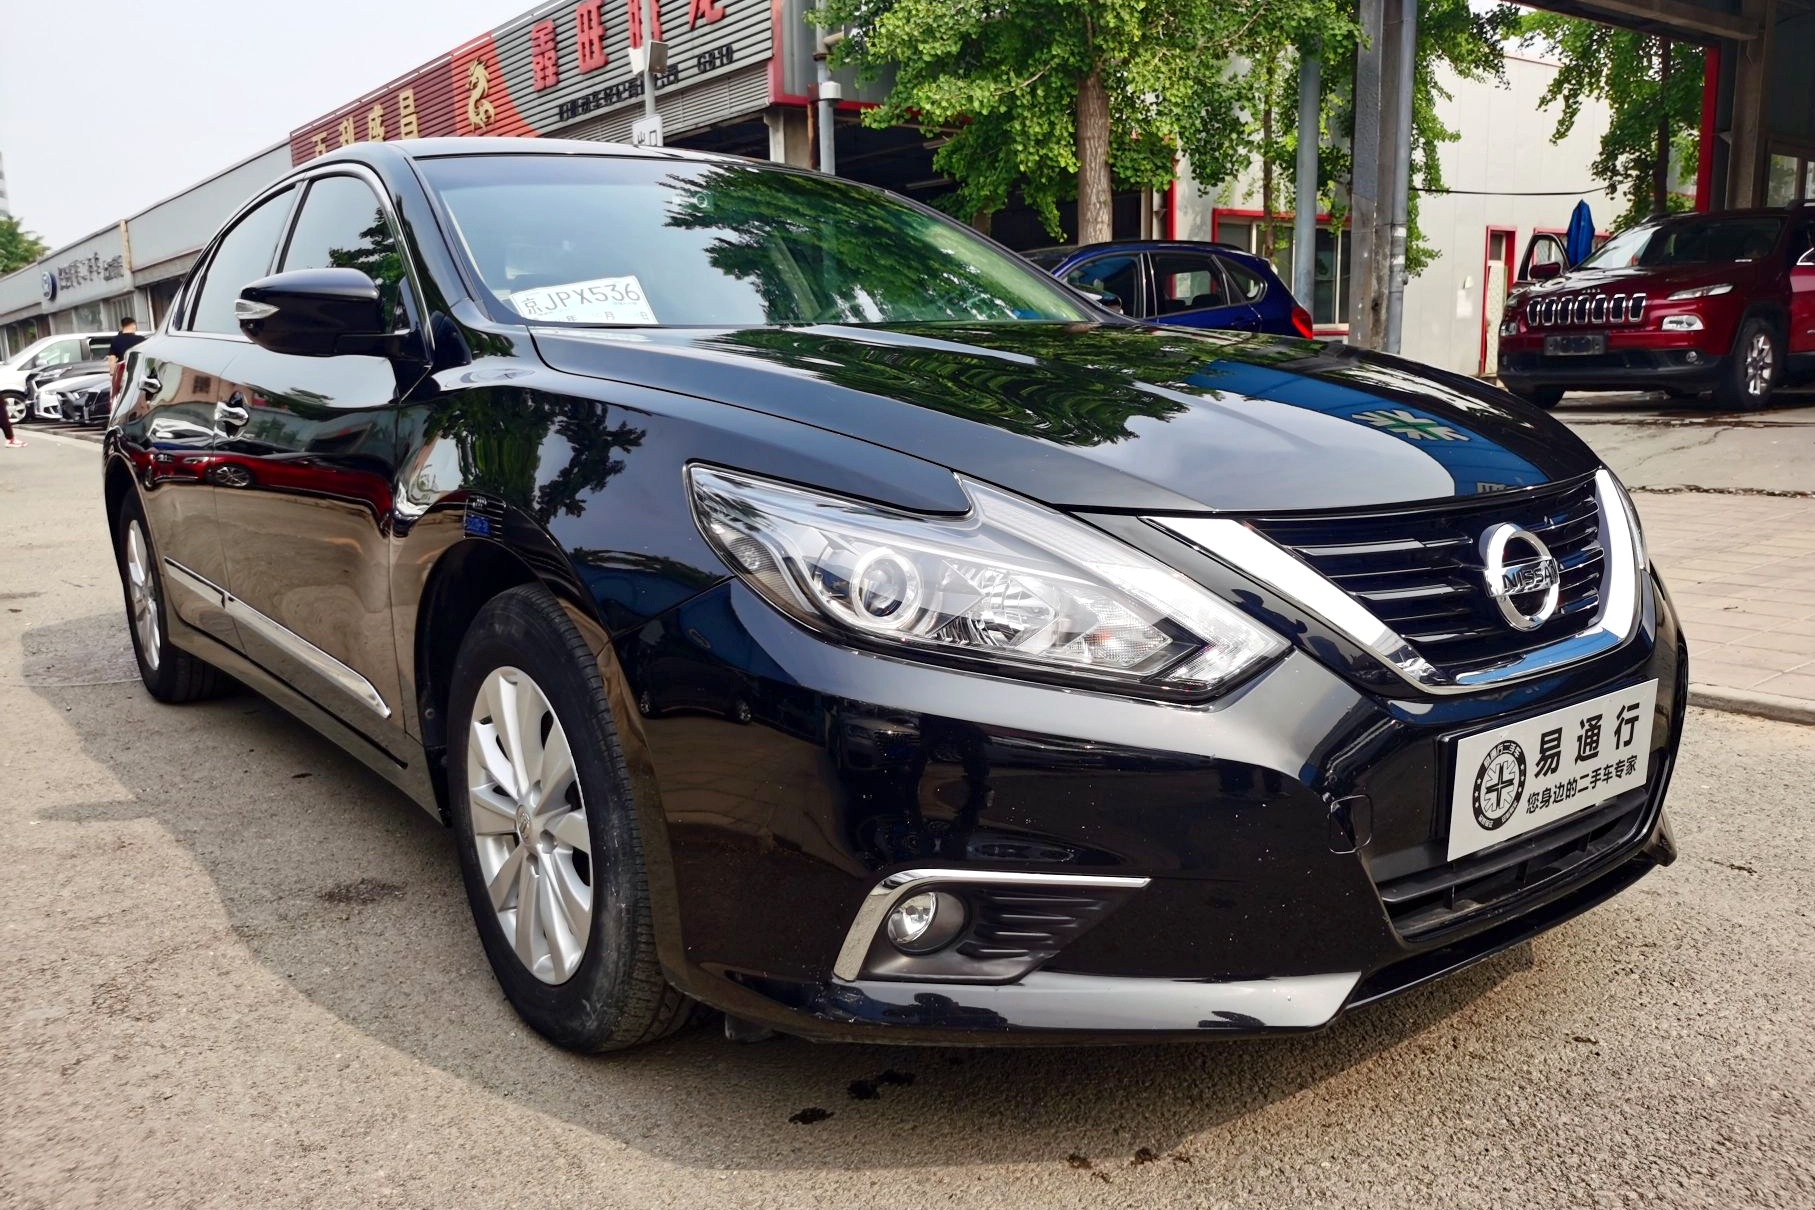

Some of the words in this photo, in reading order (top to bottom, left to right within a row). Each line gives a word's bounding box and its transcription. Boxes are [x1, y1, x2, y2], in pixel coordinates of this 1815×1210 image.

[521, 283, 641, 315] 京JPX536
[1502, 559, 1558, 590] NISSAN
[1534, 702, 1640, 779] 易通行
[1525, 754, 1638, 815] 您身边的二手车专家
